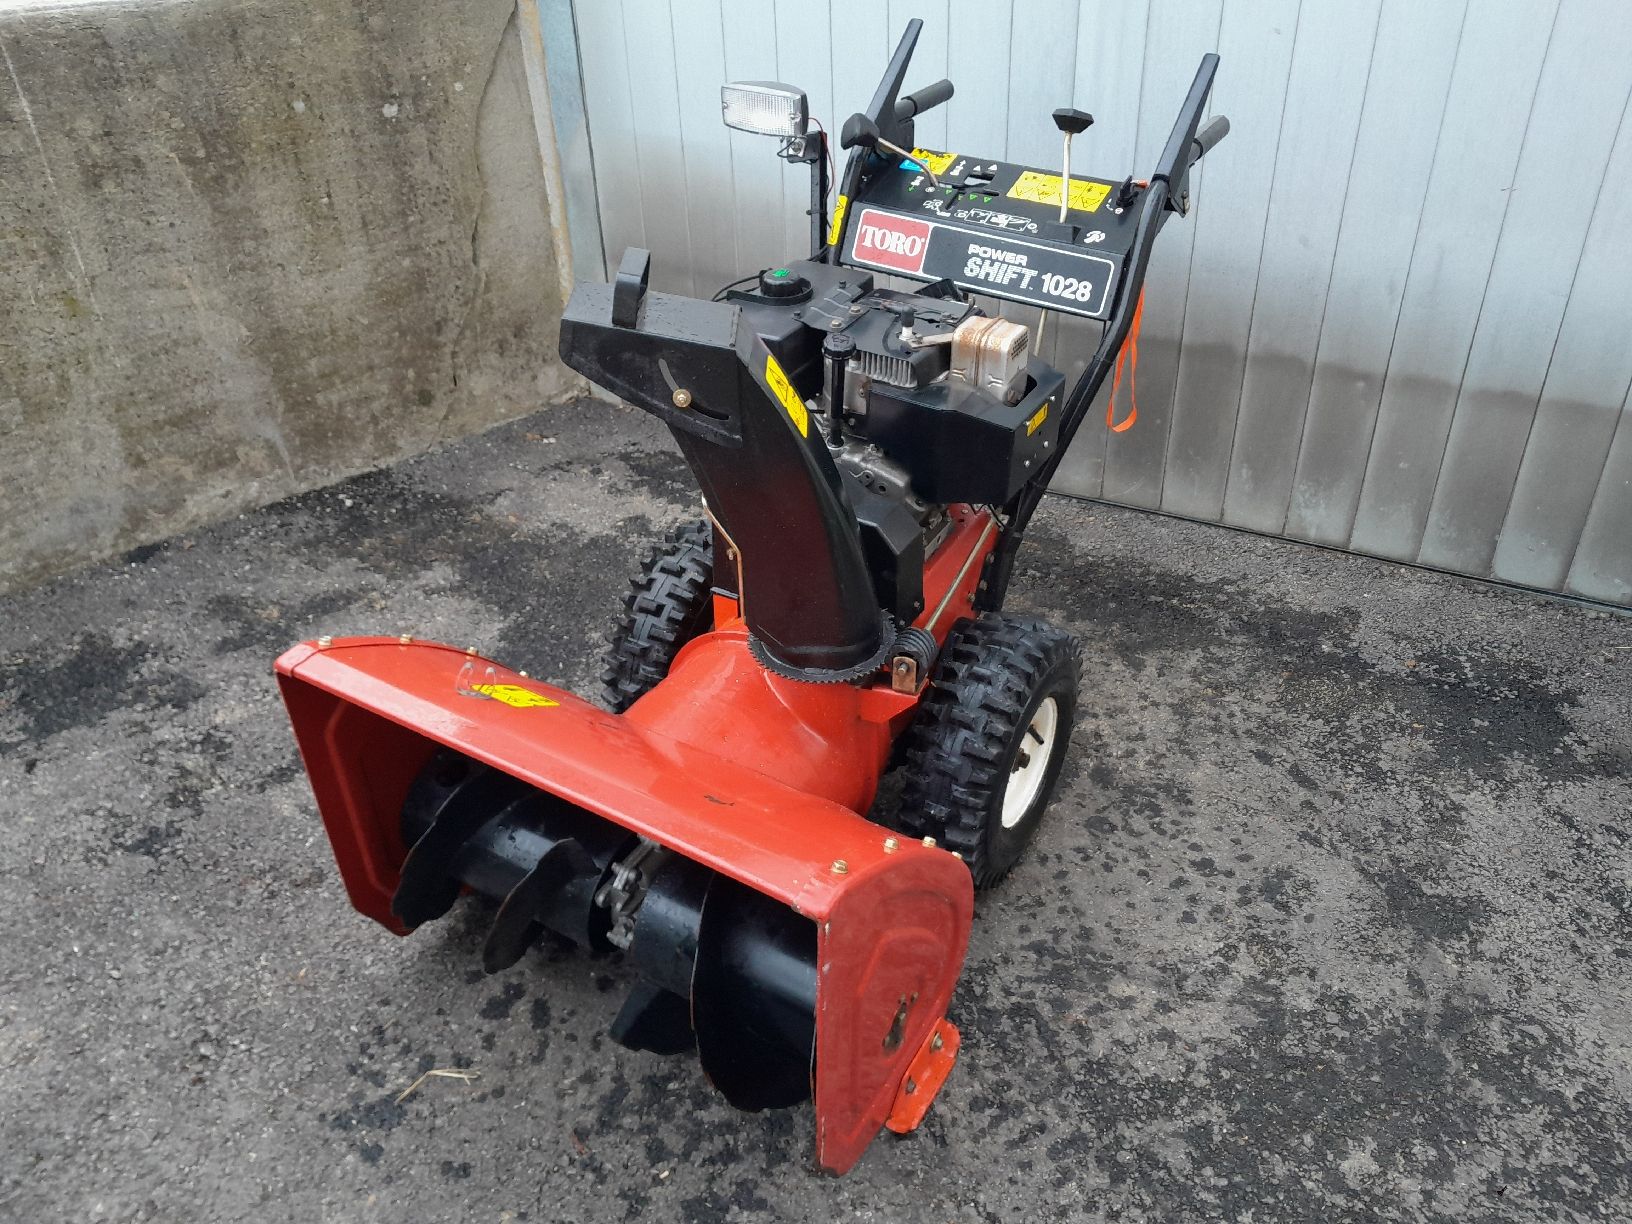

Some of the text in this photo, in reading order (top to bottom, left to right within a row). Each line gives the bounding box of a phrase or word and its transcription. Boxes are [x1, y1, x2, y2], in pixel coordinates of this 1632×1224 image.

[861, 224, 923, 257] TORO
[967, 243, 1028, 266] POWER
[963, 257, 1093, 302] SHIFT 1028
